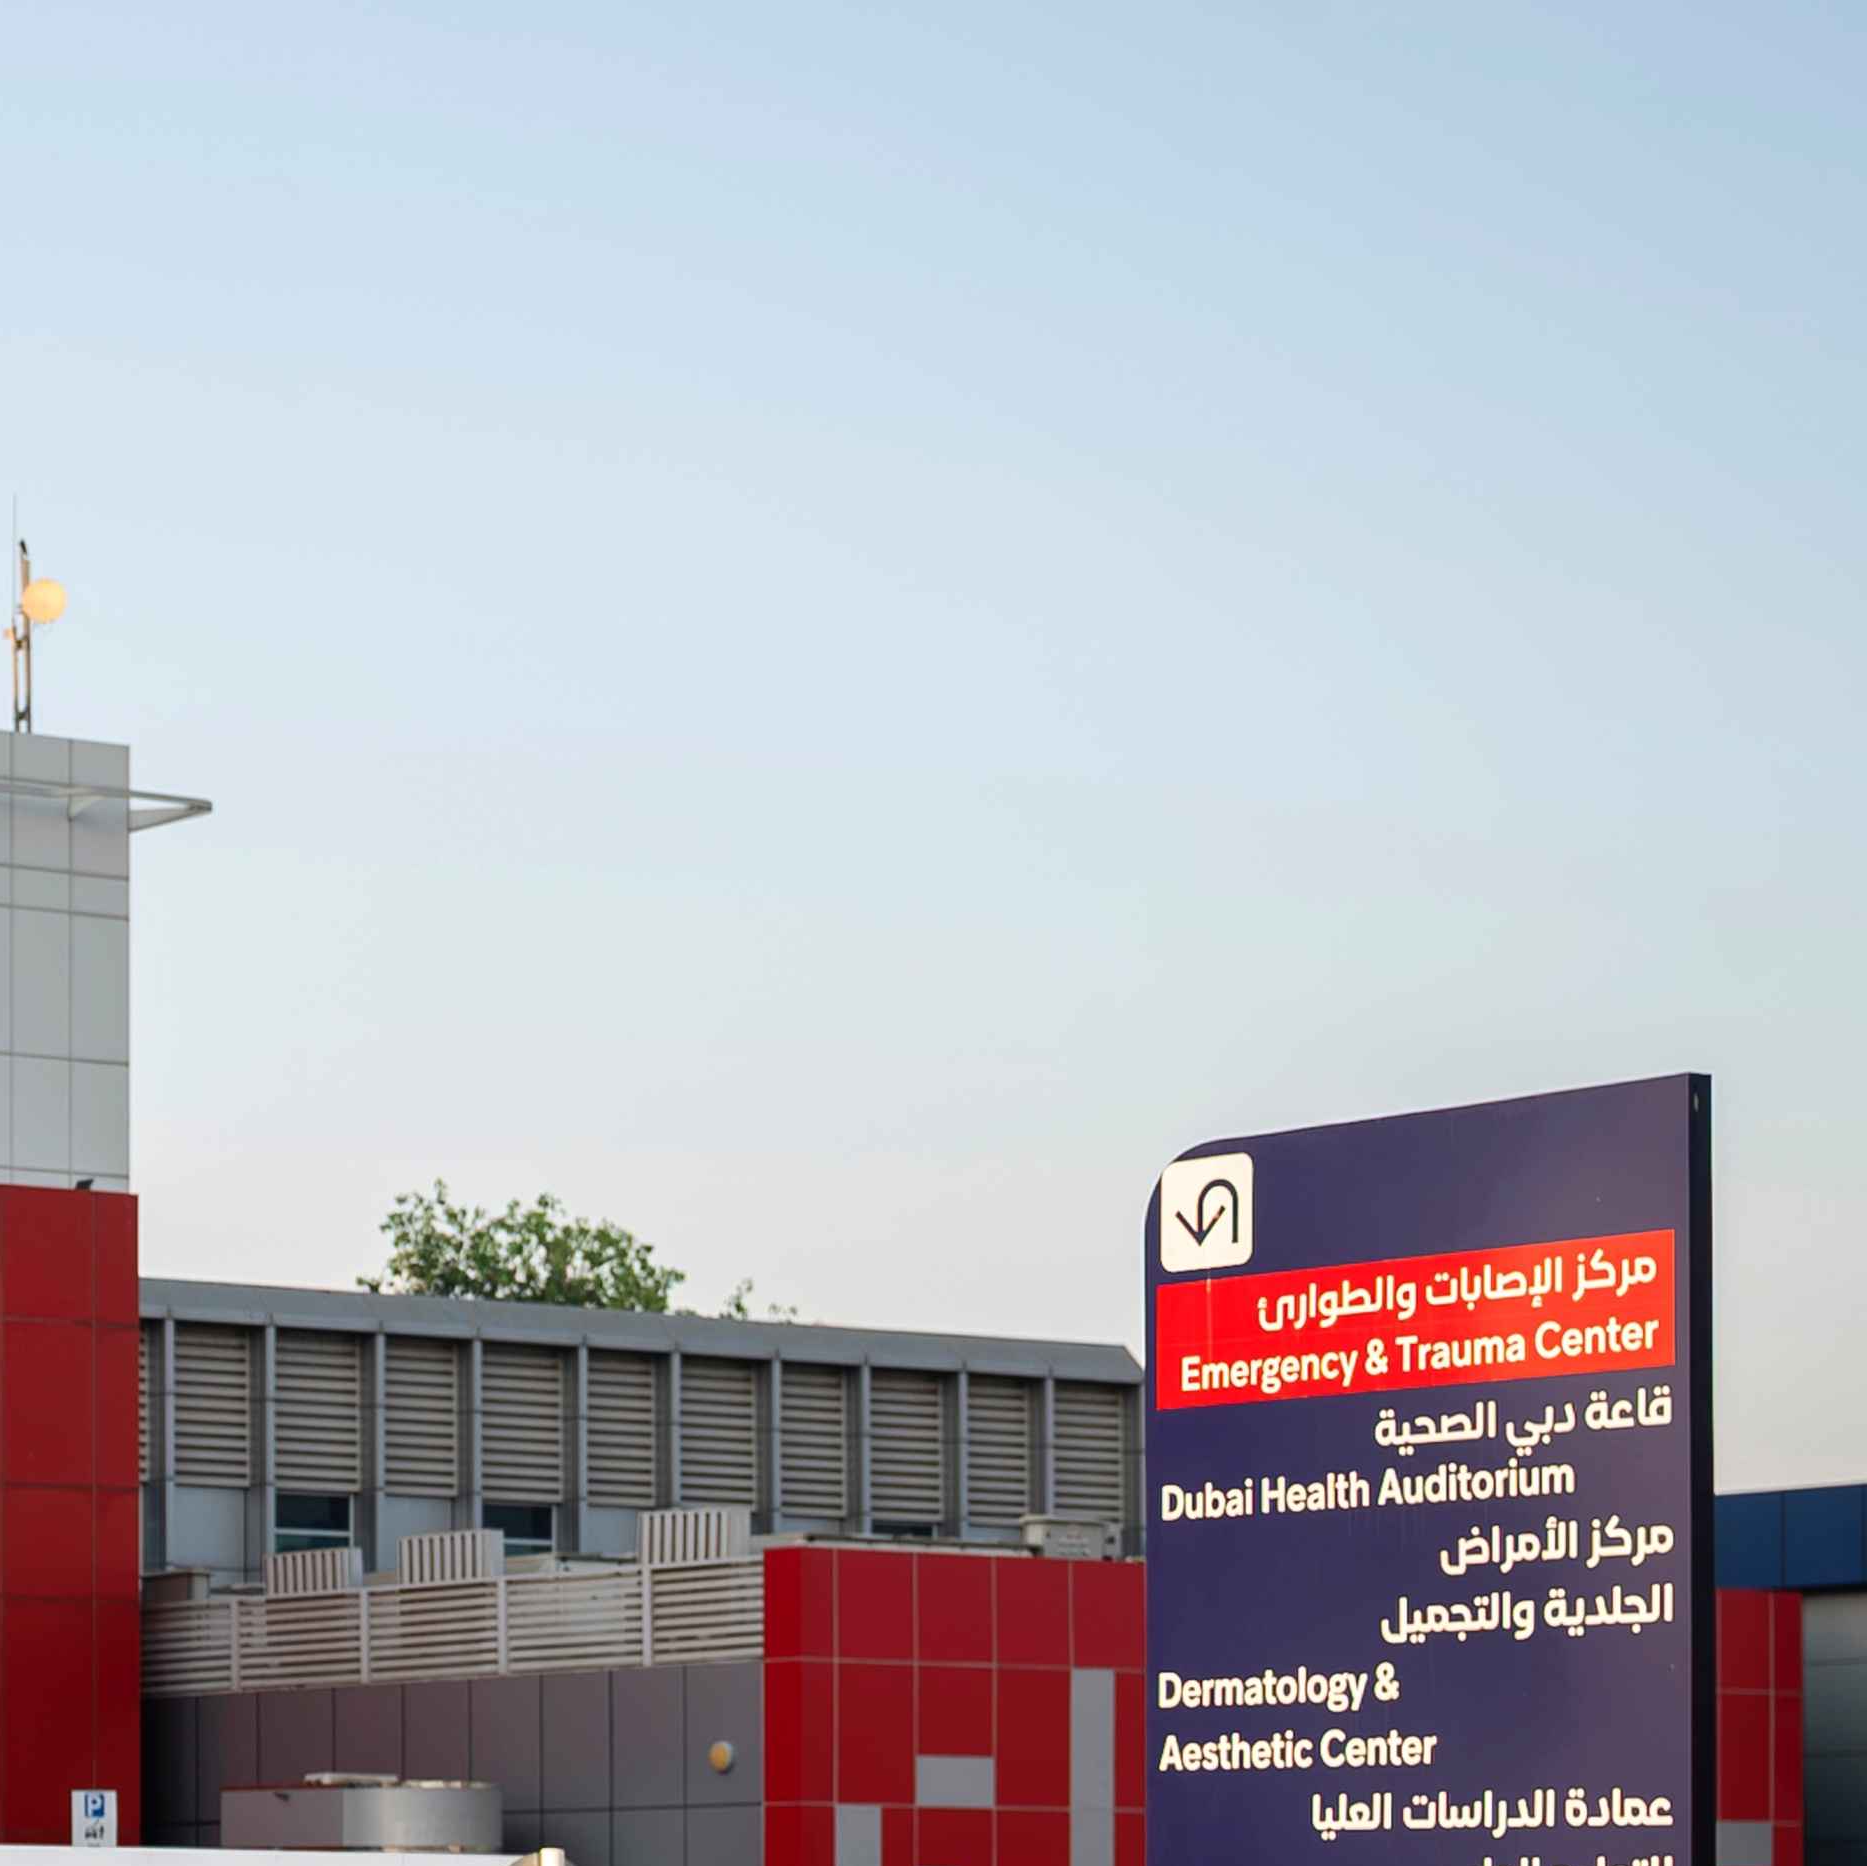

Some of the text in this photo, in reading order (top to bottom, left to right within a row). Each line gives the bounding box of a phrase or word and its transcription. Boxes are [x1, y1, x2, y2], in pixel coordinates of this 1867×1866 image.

[1257, 1247, 1658, 1332] مركز الإصابات والطوارئ
[1181, 1317, 1659, 1395] Emergency & Trauma Center
[1373, 1385, 1672, 1456] قاعة دبي الصحية
[1160, 1458, 1575, 1522] Dubai Health Auditorium
[1439, 1515, 1675, 1576] مركز الأمراض
[1380, 1582, 1674, 1643] الجلدية والتجميل
[1158, 1662, 1400, 1712] Dermatology &
[1158, 1728, 1437, 1772] Aesthetic Center
[1311, 1787, 1674, 1841] عمادة الدراسات العليا
